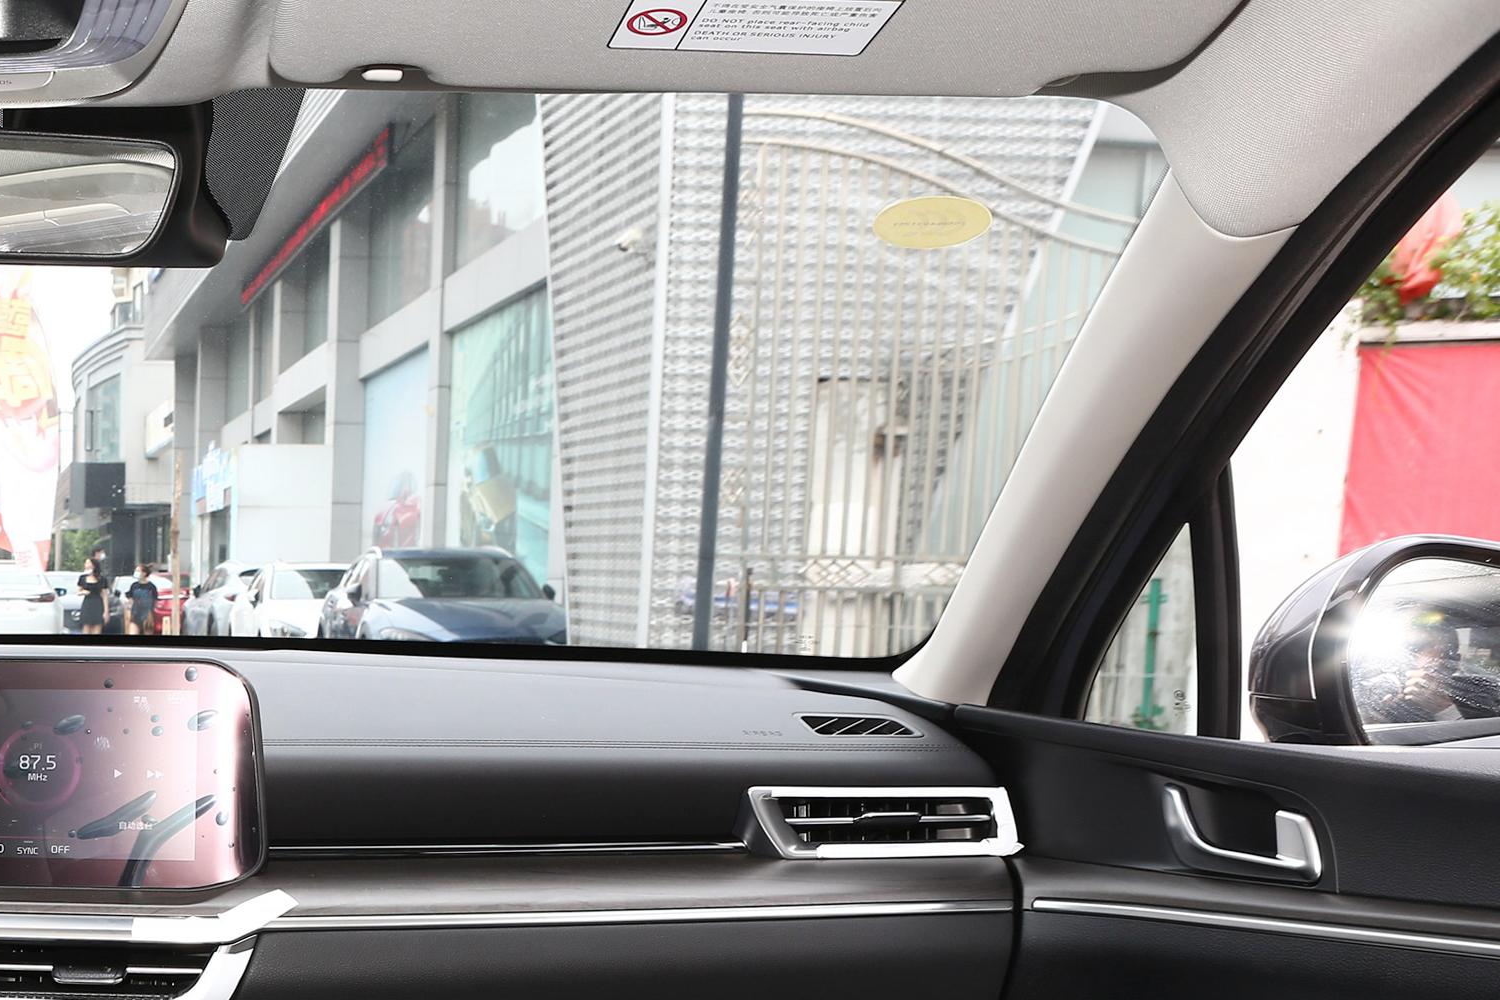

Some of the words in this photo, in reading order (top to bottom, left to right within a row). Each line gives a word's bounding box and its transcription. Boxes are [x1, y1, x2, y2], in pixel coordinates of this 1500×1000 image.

[18, 754, 57, 771] 87.5
[27, 773, 48, 782] MHz
[16, 846, 39, 856] SYNC
[50, 844, 71, 854] OFF
